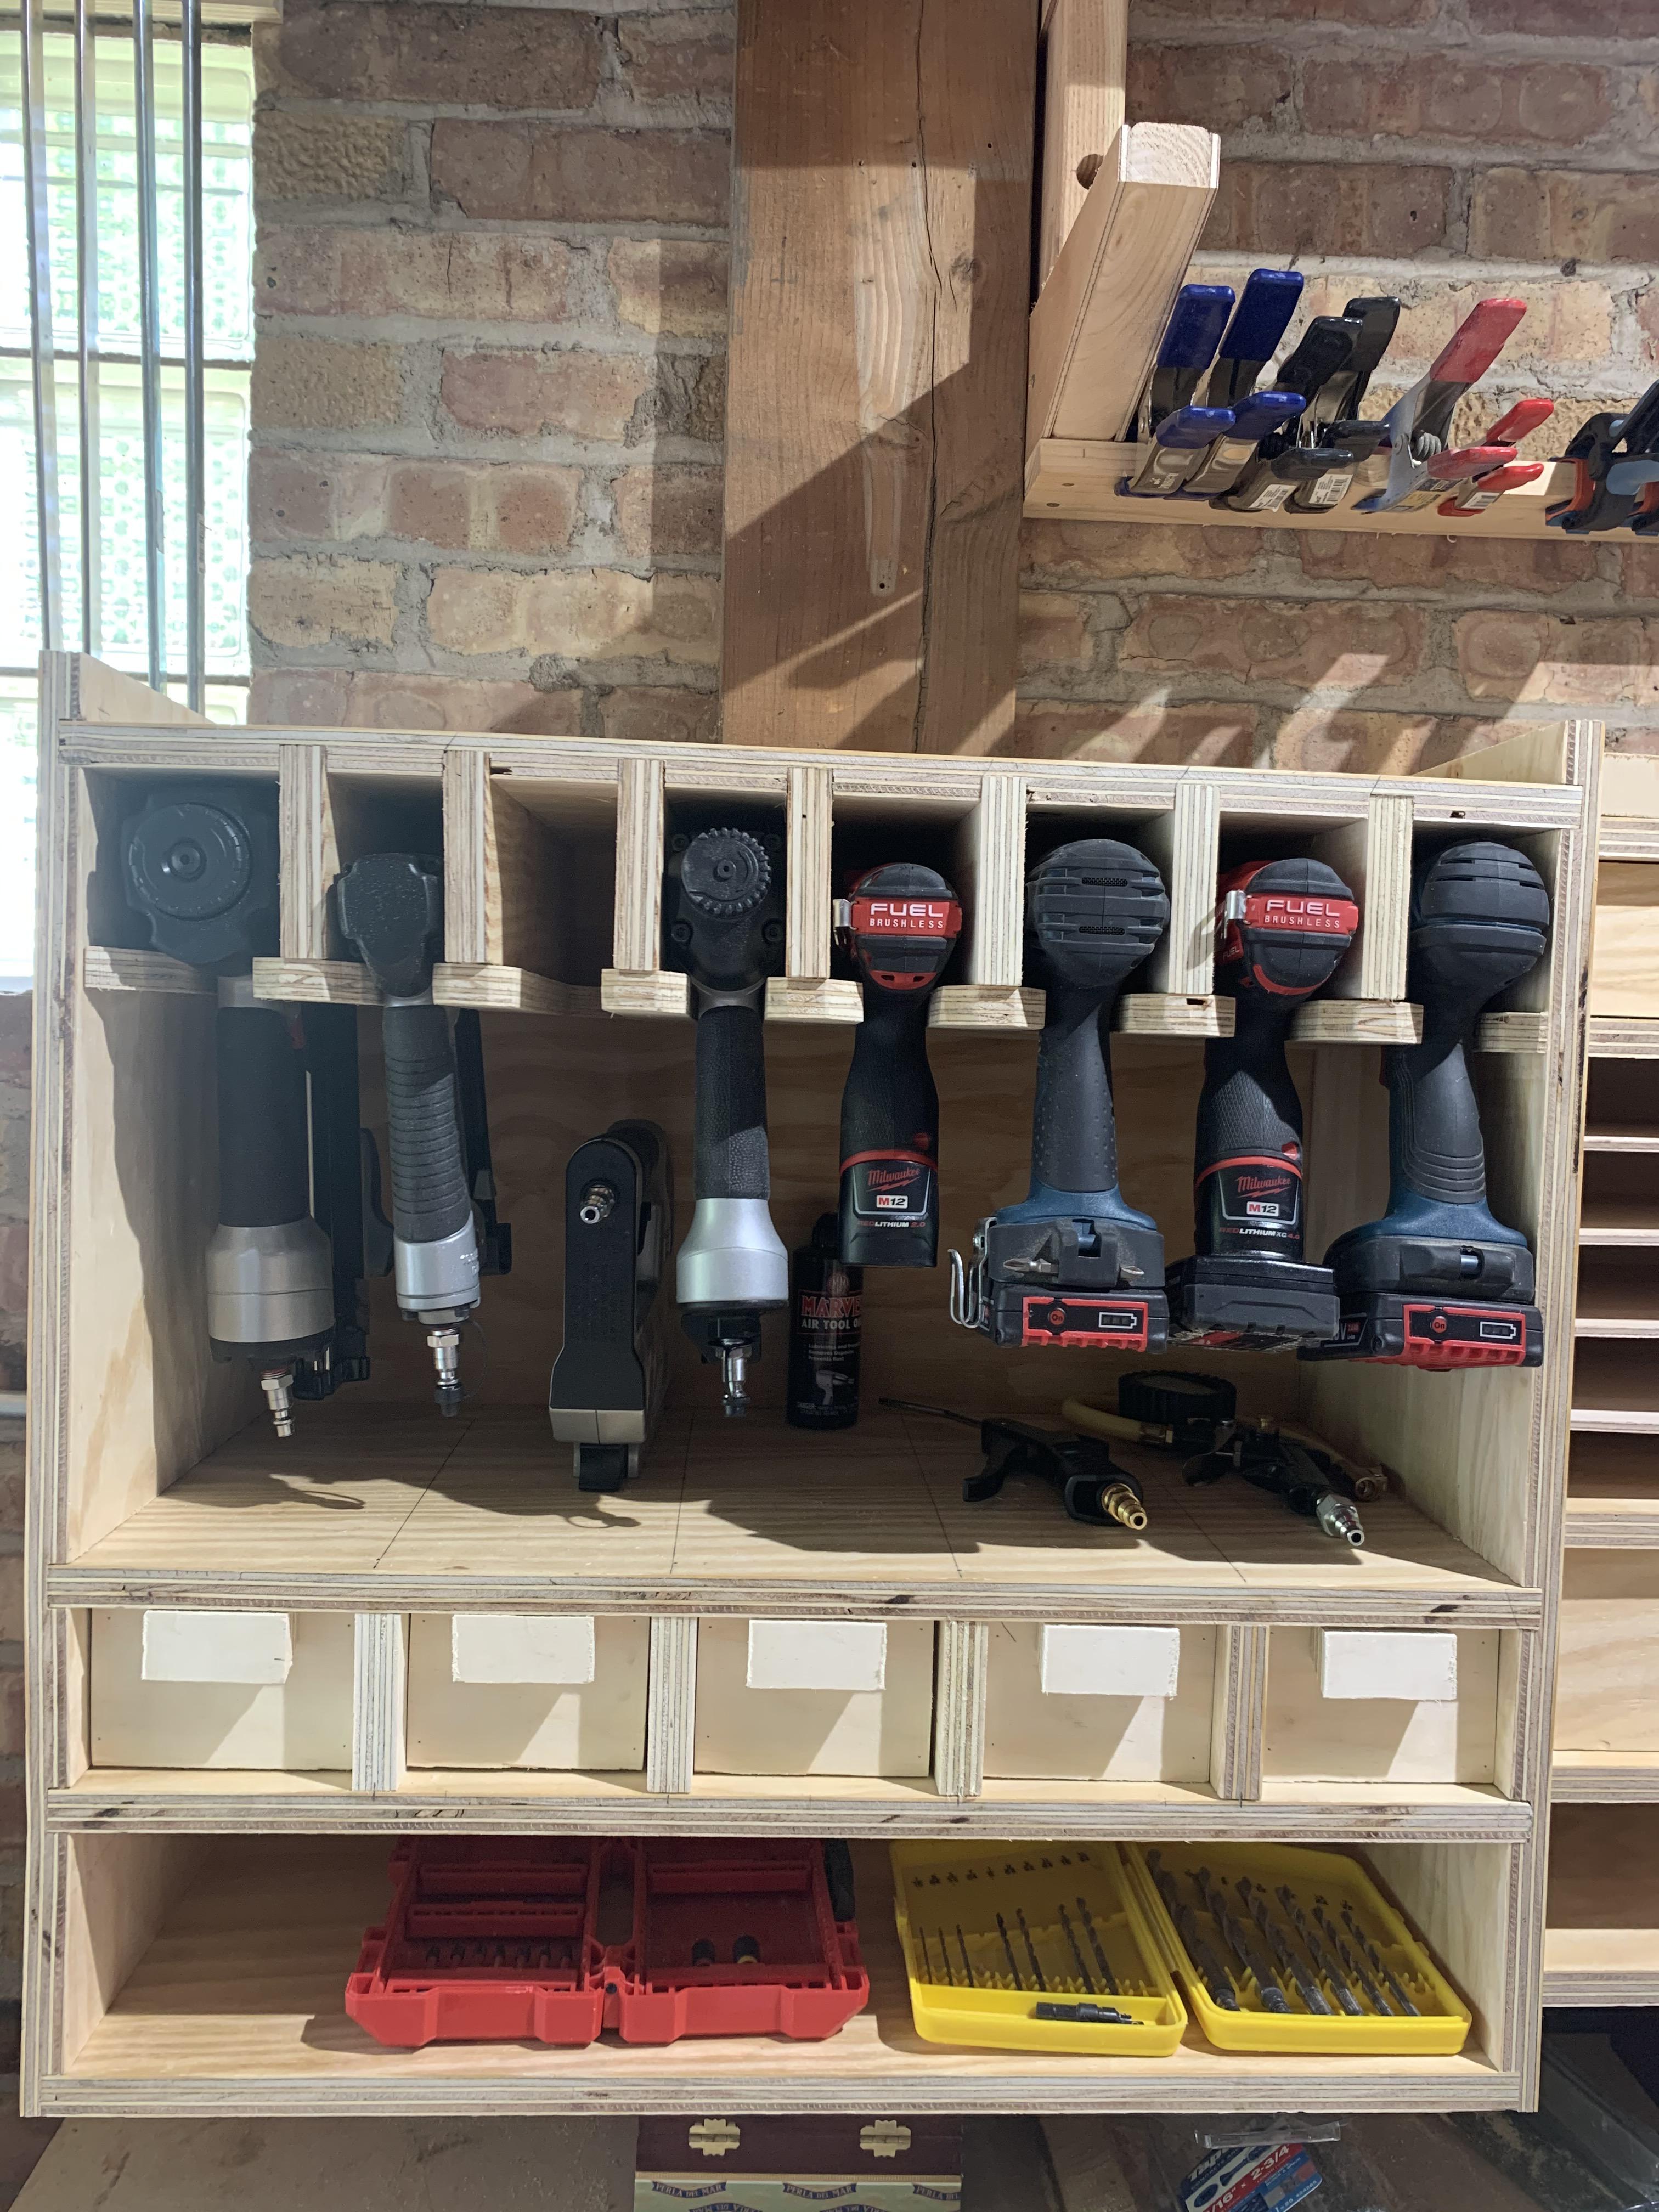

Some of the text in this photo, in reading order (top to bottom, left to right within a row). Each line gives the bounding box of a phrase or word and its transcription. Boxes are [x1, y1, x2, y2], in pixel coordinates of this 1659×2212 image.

[870, 902, 944, 917] FUEL
[1266, 899, 1340, 917] FUEL
[869, 918, 944, 929] BRUSHLESS
[1265, 915, 1340, 928] BRUSHLESS
[1223, 946, 1240, 961] FUEL
[868, 1167, 921, 1186] Milwaukee
[1235, 1175, 1291, 1193] Milwaukee
[878, 1197, 906, 1206] M12
[1249, 1204, 1277, 1214] M12
[801, 1295, 861, 1318] MARVE
[801, 1318, 819, 1329] AIR
[823, 1319, 850, 1330] TOOL
[1051, 1313, 1063, 1322] On
[1434, 1321, 1446, 1329] On
[656, 2183, 682, 2197] PERLA
[702, 2184, 722, 2196] MAR
[787, 2185, 813, 2199] PERLA
[832, 2185, 852, 2197] MAR
[917, 2185, 943, 2199] PERLA
